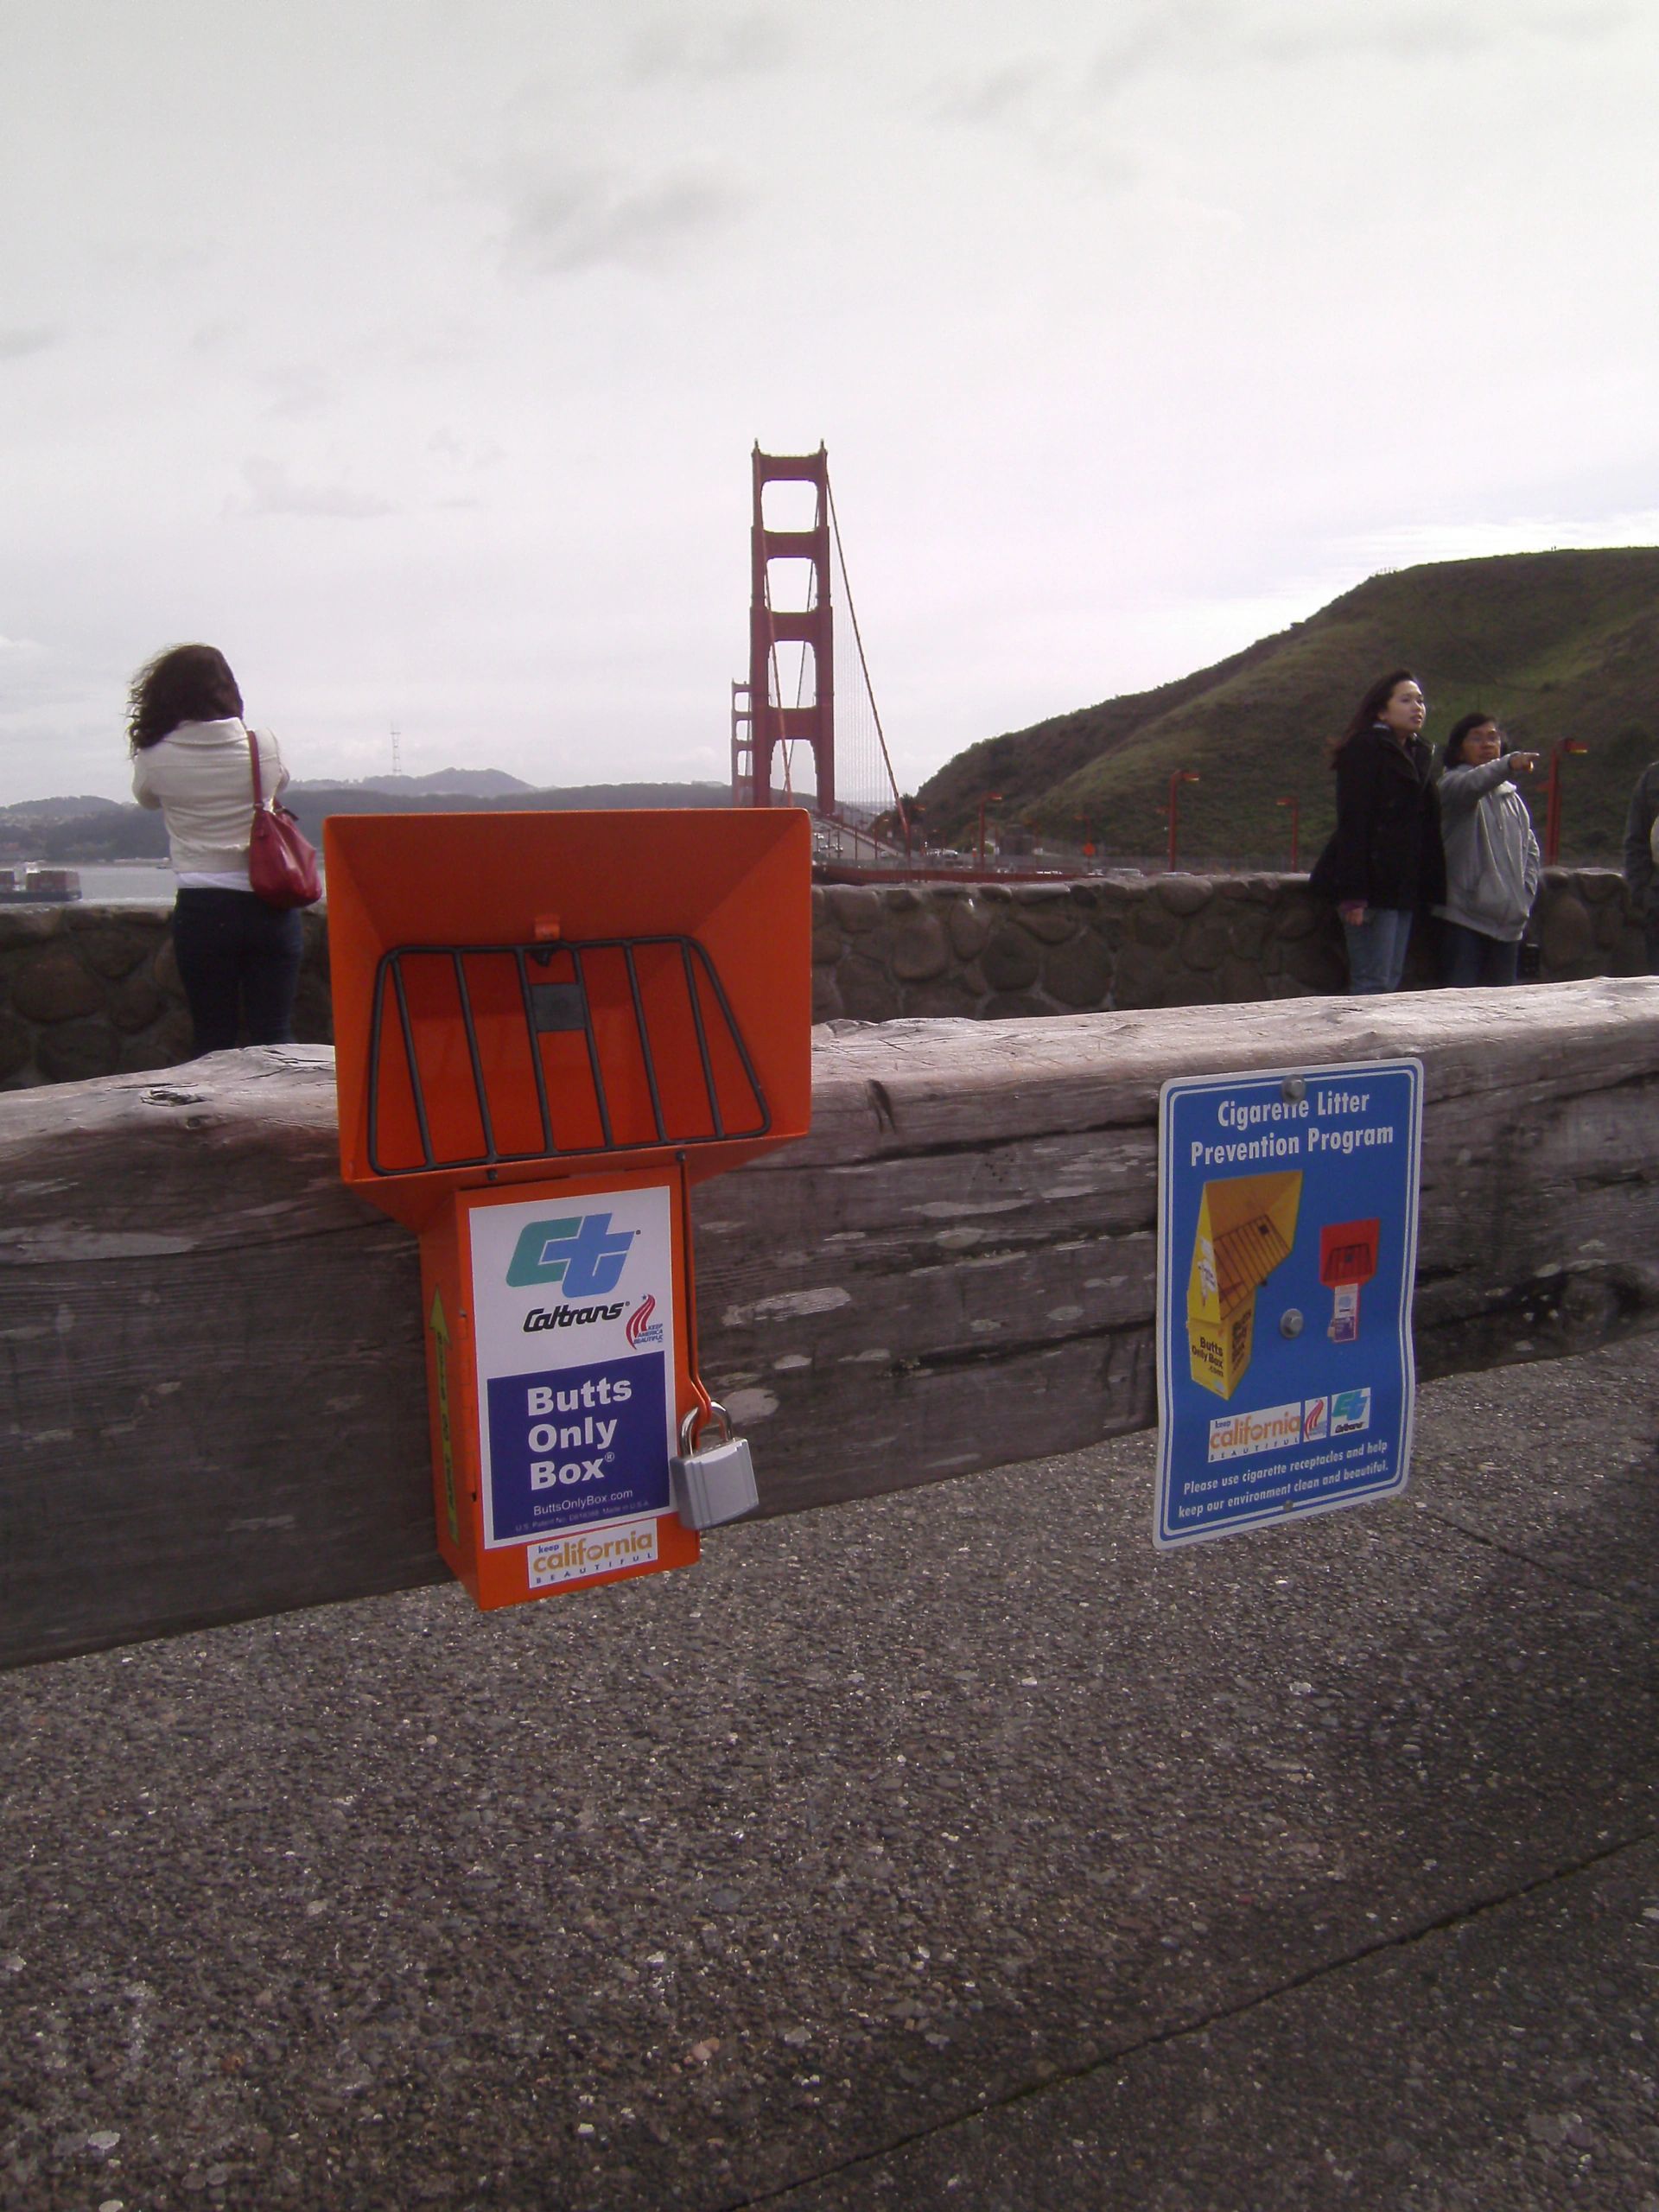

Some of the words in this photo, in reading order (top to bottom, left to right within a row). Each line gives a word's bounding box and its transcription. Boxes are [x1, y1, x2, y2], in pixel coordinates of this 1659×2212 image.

[1318, 1090, 1370, 1116] Litter
[1191, 1132, 1300, 1166] Prevention
[1308, 1126, 1393, 1154] Program
[523, 1302, 625, 1332] Caltrans
[1200, 1337, 1224, 1357] Butts
[527, 1377, 632, 1416] Butts
[528, 1416, 618, 1452] Only
[1211, 1412, 1300, 1449] california
[1211, 1437, 1298, 1460] BEAUTIFUL
[1184, 1480, 1218, 1495] Please
[1222, 1475, 1239, 1486] use
[1243, 1464, 1287, 1483] cigarette
[1290, 1451, 1344, 1471] receptacles
[1346, 1444, 1364, 1459] and
[1368, 1440, 1388, 1453] help
[534, 1490, 633, 1516] ButtsOnlyBox.com
[1179, 1505, 1204, 1518] keep
[1207, 1500, 1224, 1511] our
[1228, 1484, 1291, 1507] environment
[1294, 1478, 1319, 1491] clean
[1323, 1470, 1341, 1484] and
[1344, 1460, 1389, 1480] beautiful.
[533, 1531, 652, 1573] california
[538, 1544, 559, 1554] keep
[536, 1553, 652, 1584] BEAUTIFUL
